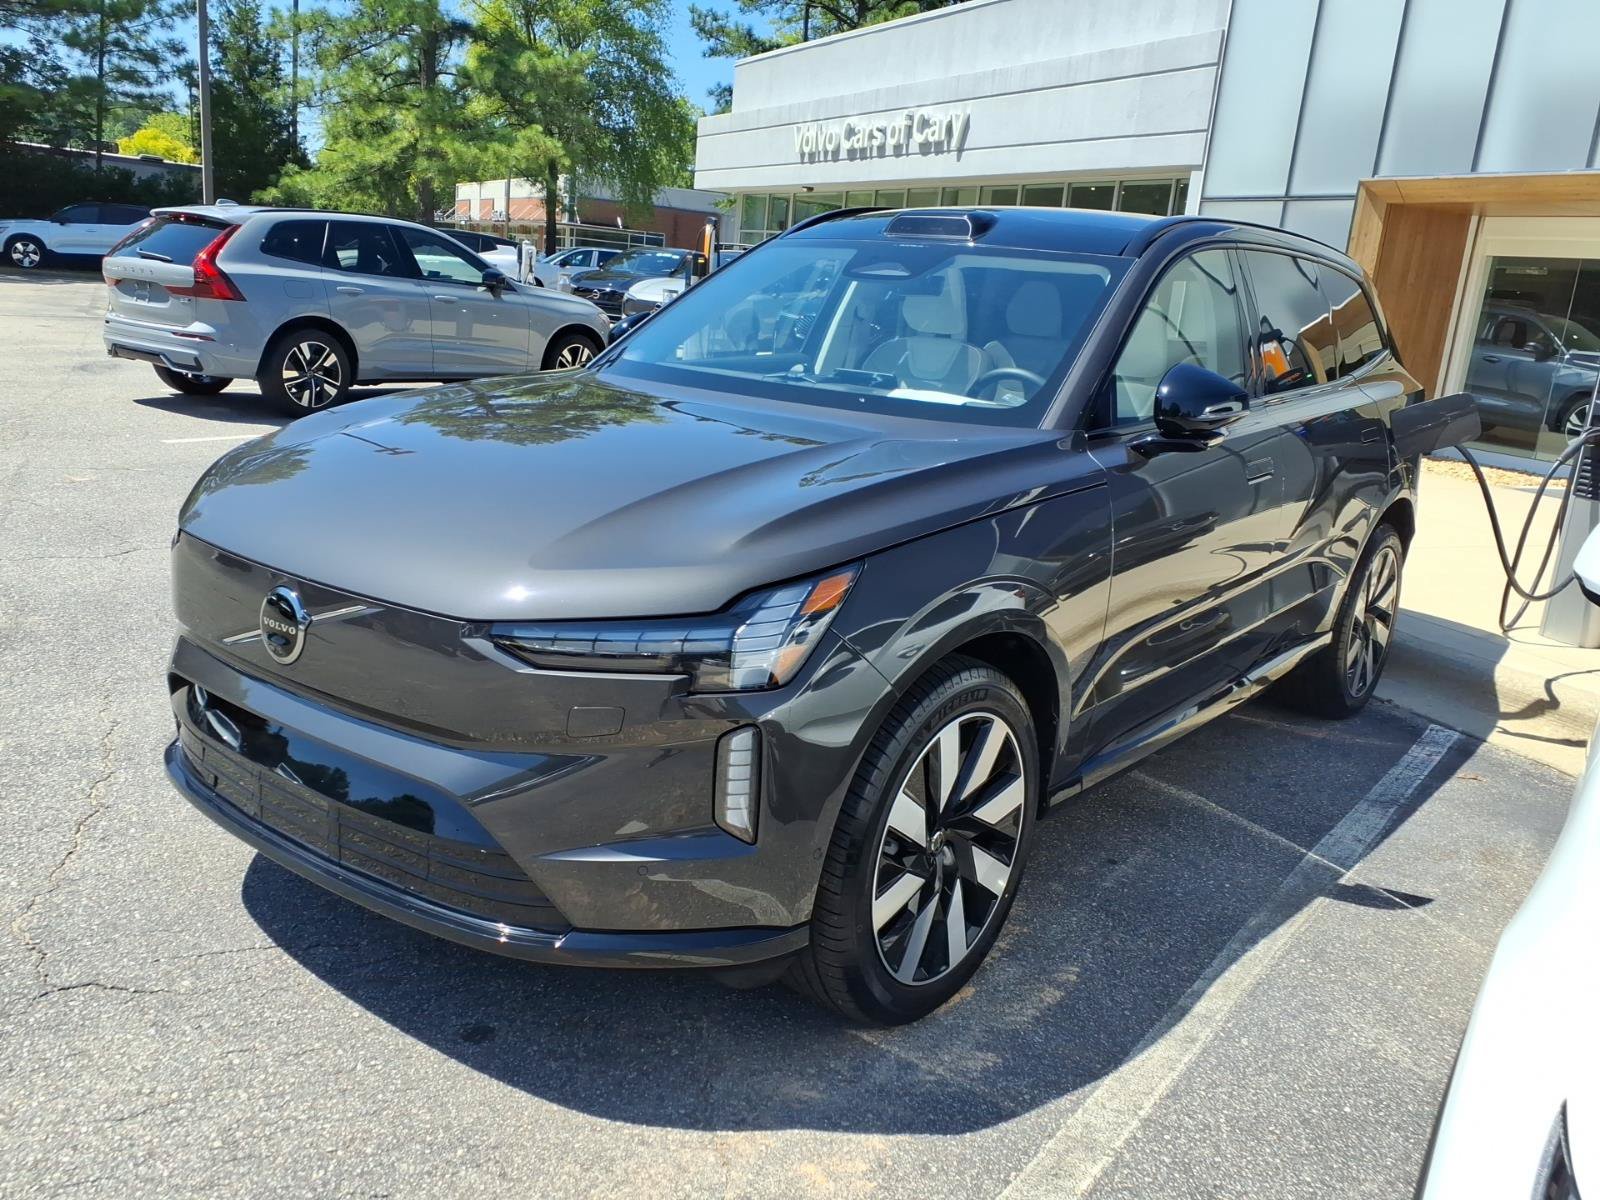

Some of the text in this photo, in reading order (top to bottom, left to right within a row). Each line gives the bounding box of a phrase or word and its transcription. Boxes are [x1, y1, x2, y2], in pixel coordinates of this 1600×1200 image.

[794, 109, 970, 153] Volvo Cars of Cary
[263, 617, 296, 635] VOLVO
